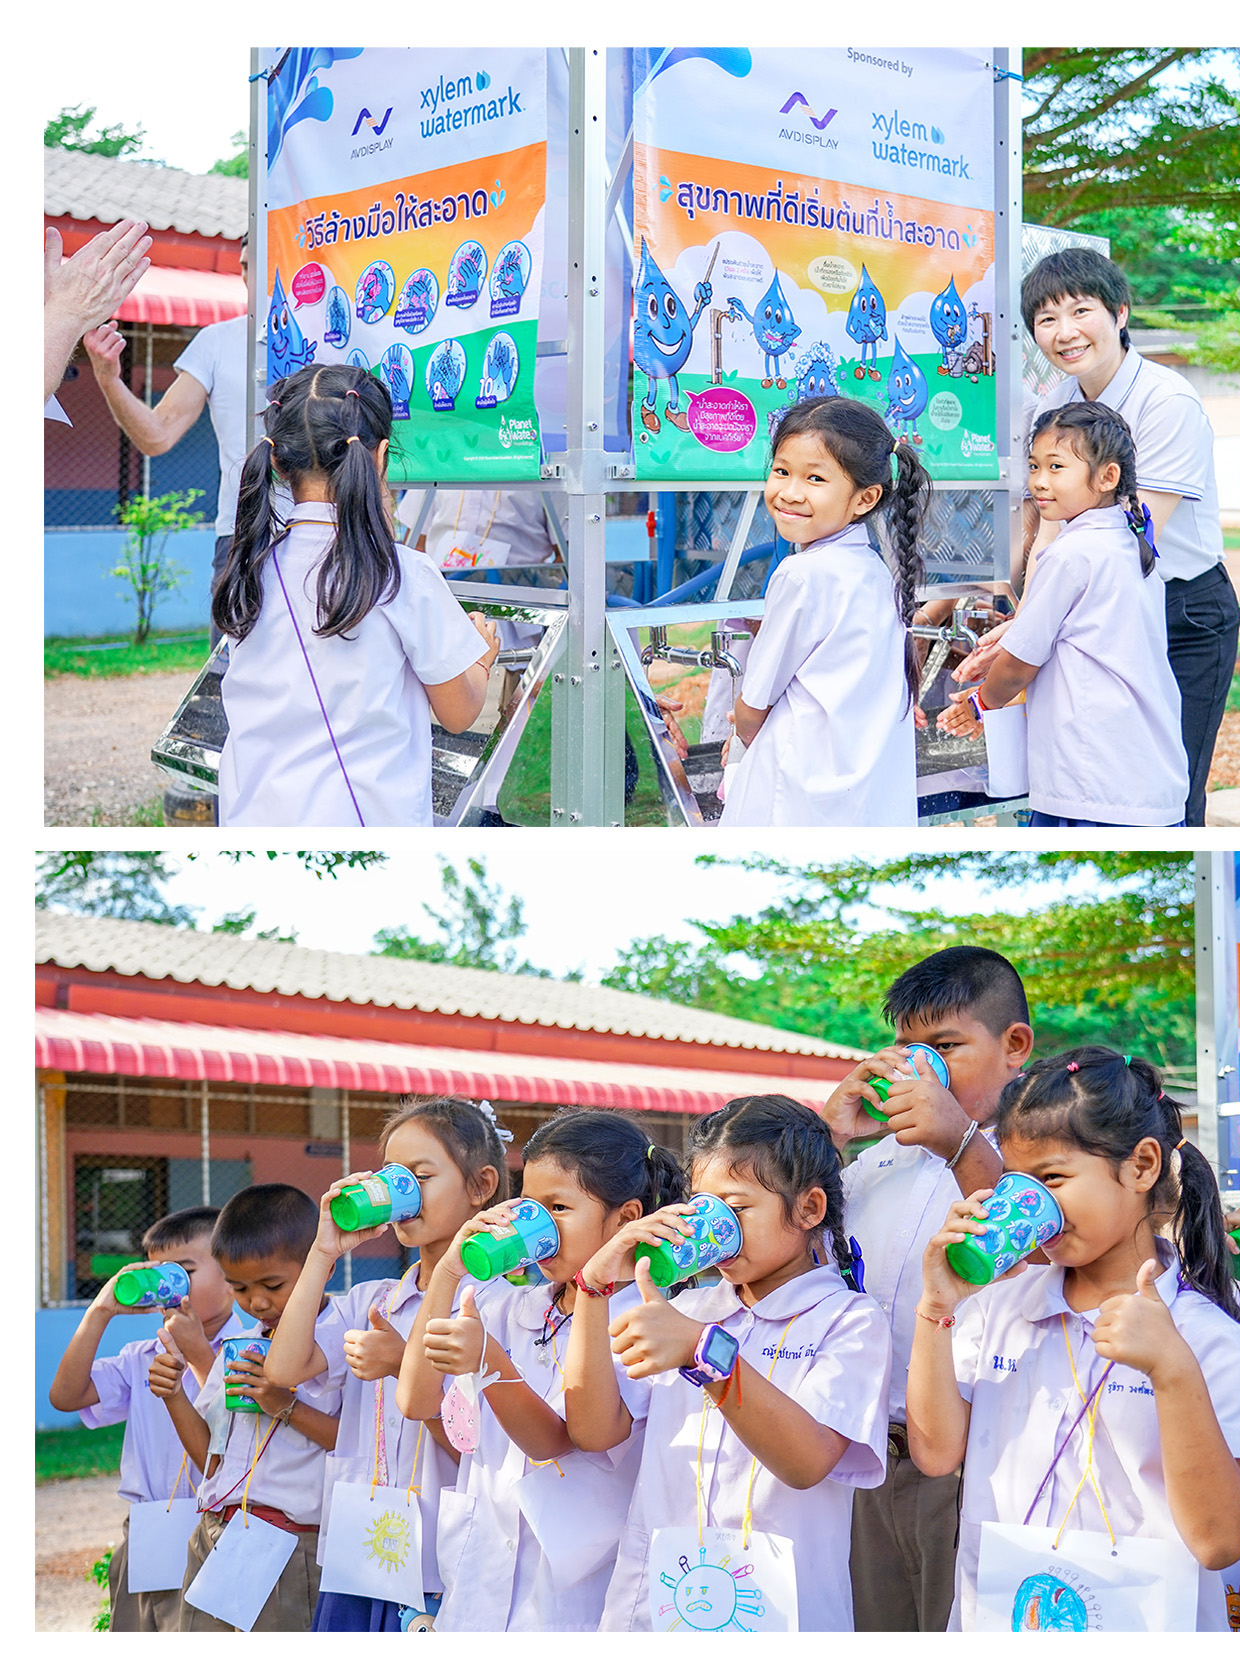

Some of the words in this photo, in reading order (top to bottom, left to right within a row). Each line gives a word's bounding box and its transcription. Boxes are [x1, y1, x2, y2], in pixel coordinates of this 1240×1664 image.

[847, 47, 899, 72] Sponsored
[901, 61, 914, 77] by
[419, 75, 473, 114] xylem
[420, 85, 522, 138] watermark
[872, 109, 928, 141] xylem
[350, 138, 394, 160] AVDISPLAY
[778, 128, 839, 149] AVDISPLAY
[872, 140, 970, 180] watermark
[306, 190, 488, 250] วิธีล้างมือให้สะอาด
[677, 180, 960, 250] สุขภาพที่ดีเริ่มต้นที่น้ำสะอาด
[359, 288, 366, 308] 2
[493, 280, 501, 301] 5
[433, 381, 441, 401] 9
[479, 377, 493, 398] 10
[508, 418, 533, 430] Planet
[511, 430, 531, 440] Wate
[971, 433, 990, 443] Planet
